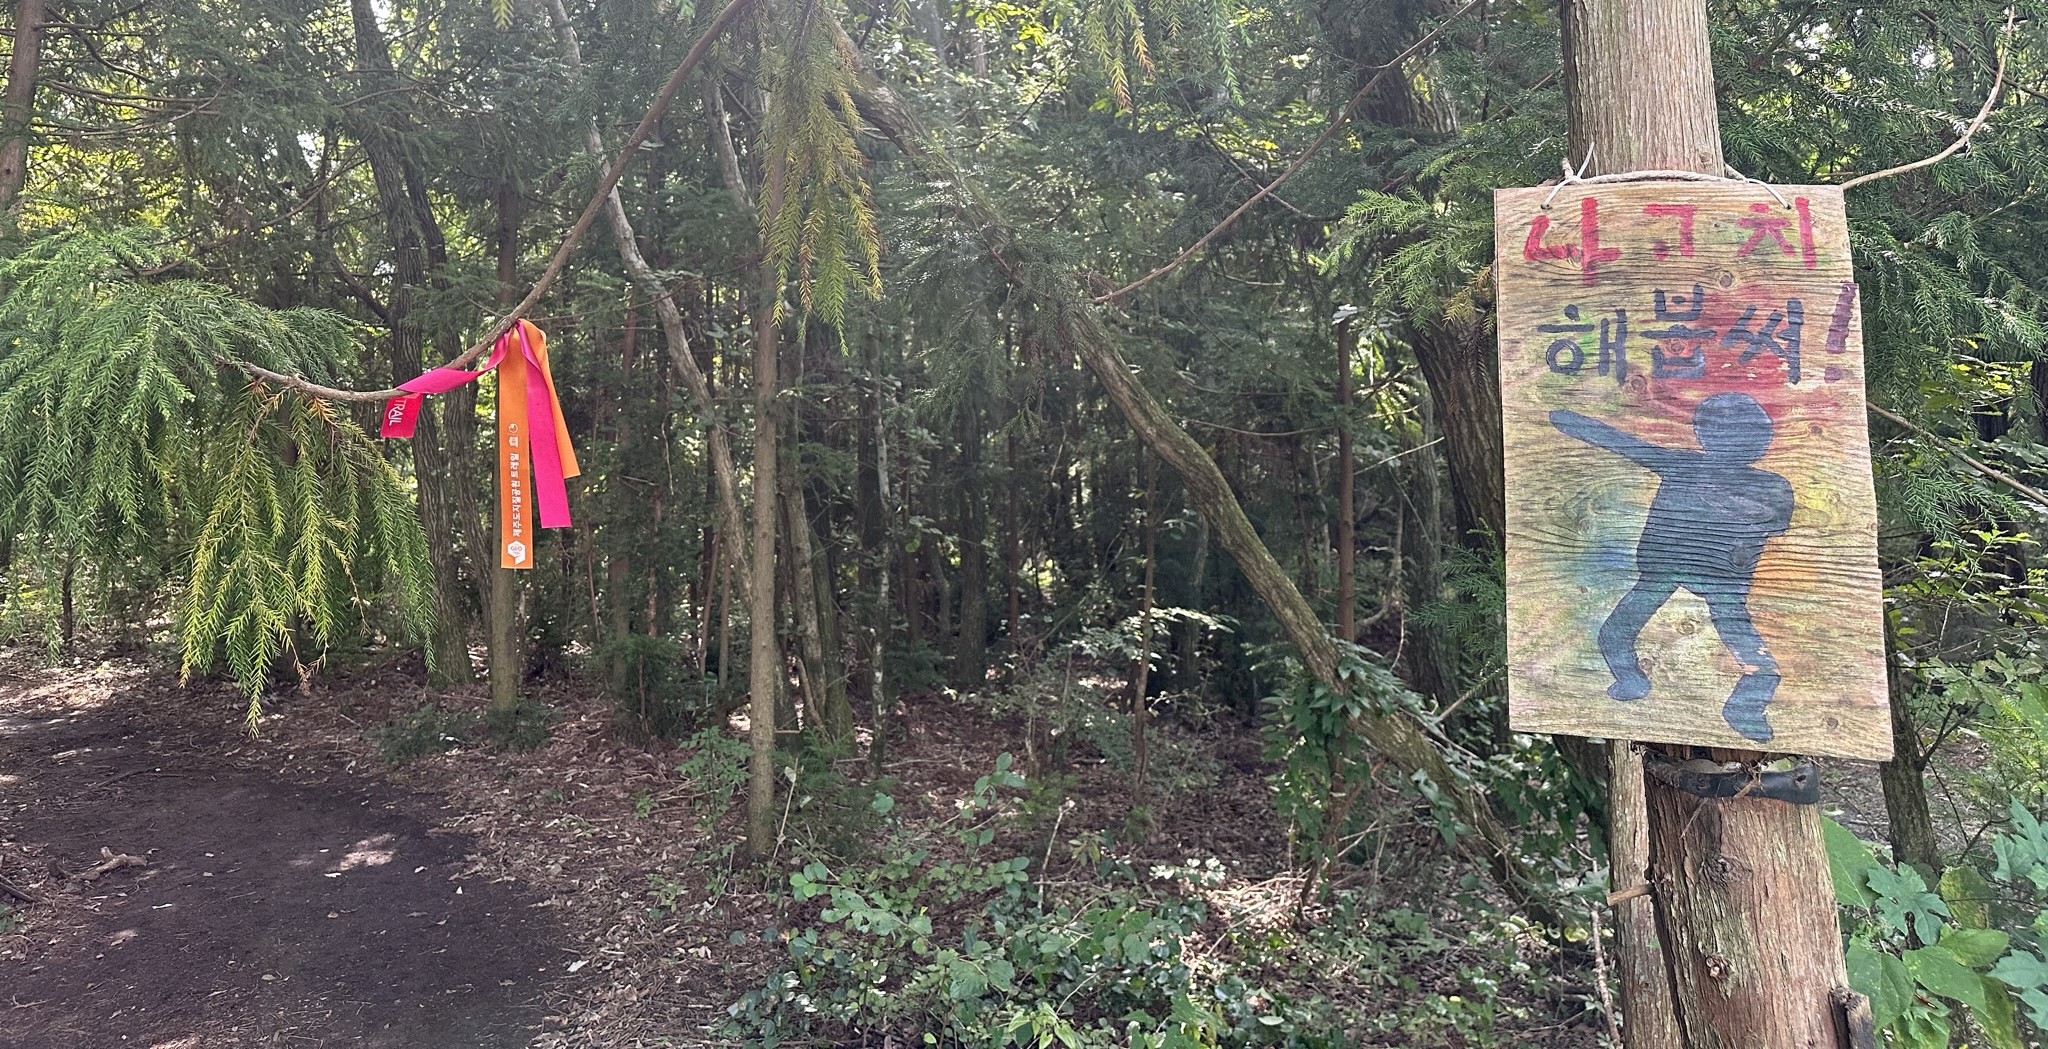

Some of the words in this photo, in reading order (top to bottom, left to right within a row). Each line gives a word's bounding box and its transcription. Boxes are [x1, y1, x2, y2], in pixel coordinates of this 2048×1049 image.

[388, 398, 407, 426] TRAIL
[510, 453, 520, 478] 트레일
[510, 480, 522, 537] 제주도지질공원
